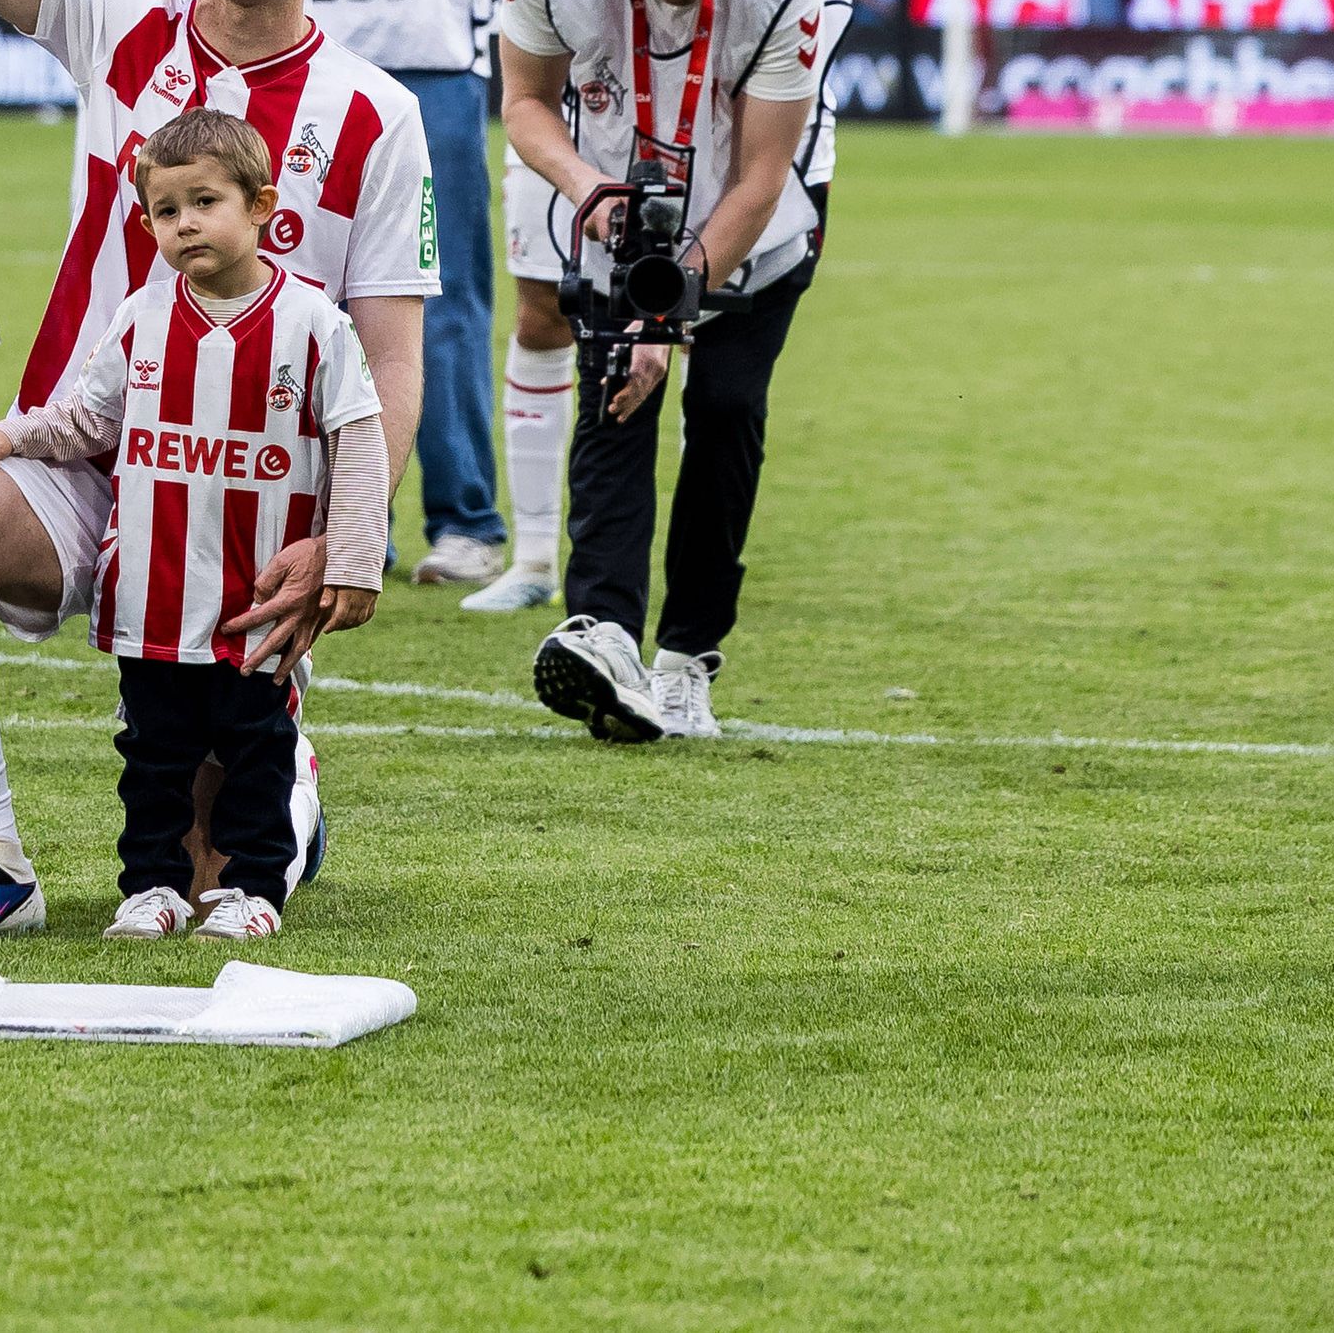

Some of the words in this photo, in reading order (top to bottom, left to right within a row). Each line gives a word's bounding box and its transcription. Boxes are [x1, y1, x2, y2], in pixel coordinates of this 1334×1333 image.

[150, 80, 184, 107] hummel
[422, 186, 436, 262] DEVK
[130, 381, 160, 391] hummel
[126, 427, 250, 479] REWE
